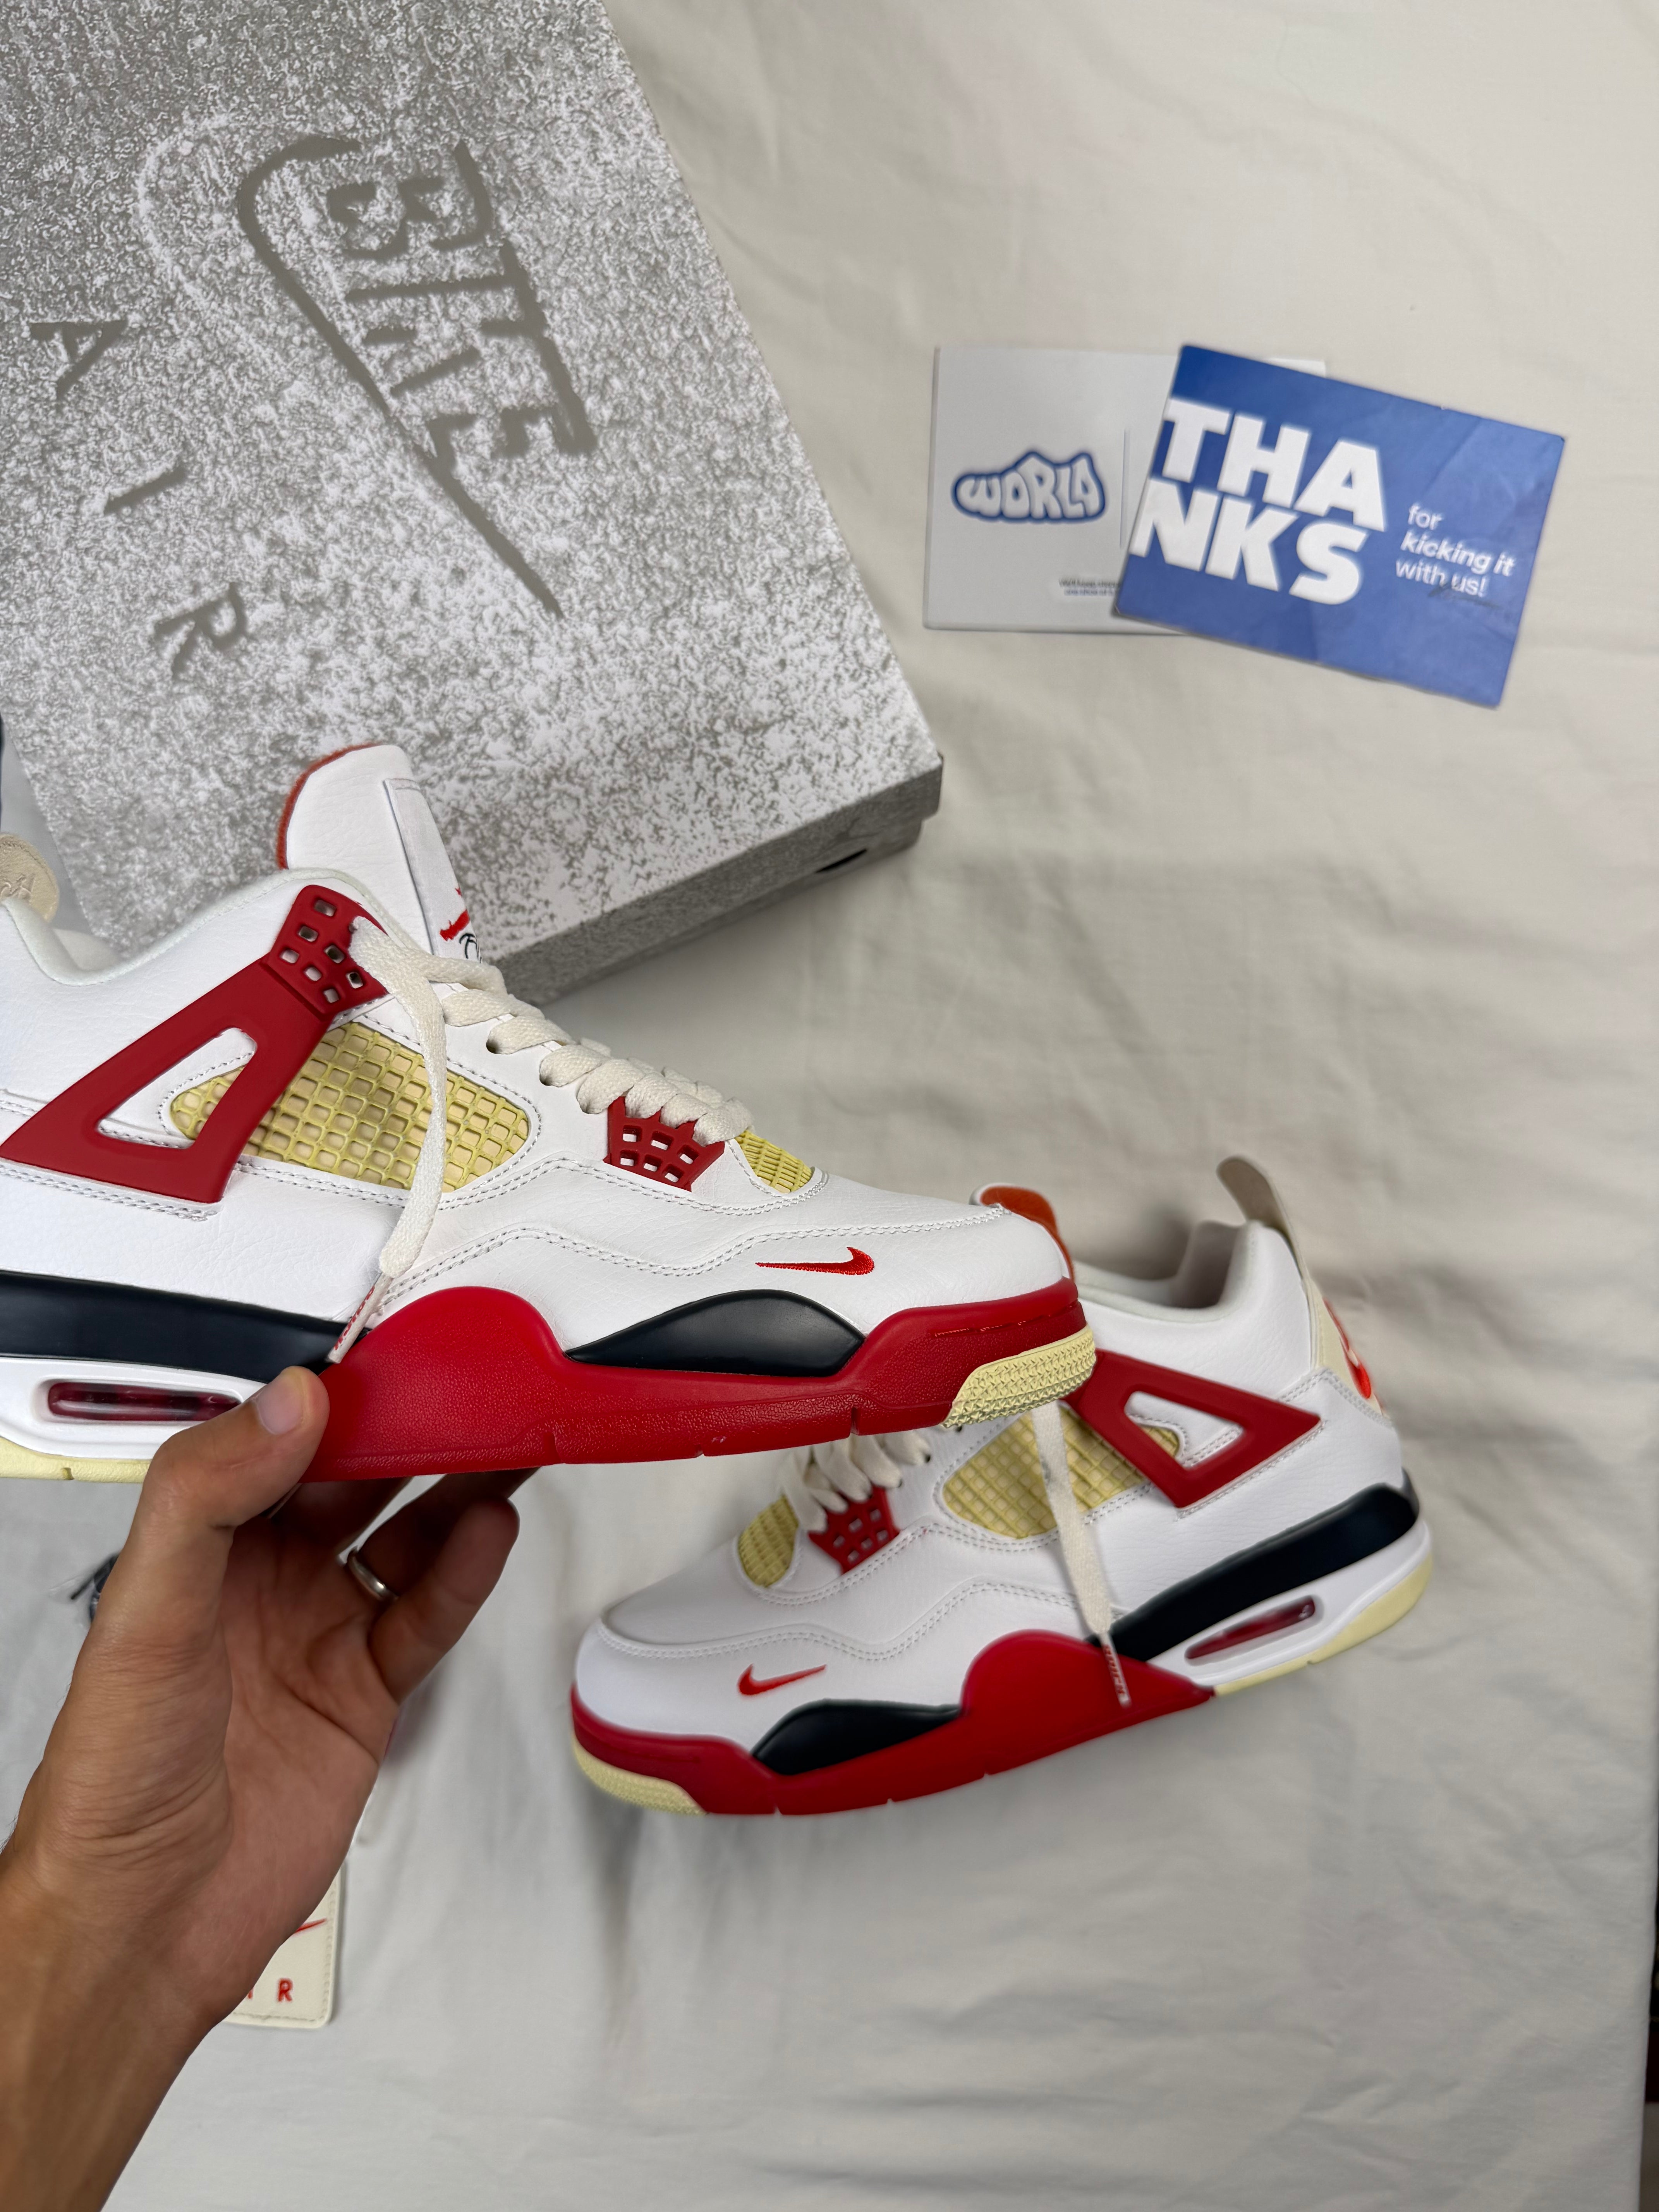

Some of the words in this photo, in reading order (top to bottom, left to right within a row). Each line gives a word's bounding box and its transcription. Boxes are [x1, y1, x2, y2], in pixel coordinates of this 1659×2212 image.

[29, 318, 252, 678] AIR
[1163, 398, 1385, 532] THA
[1128, 478, 1369, 605] NKS
[1400, 530, 1492, 575] kicking
[1493, 552, 1515, 577] it
[1408, 503, 1443, 530] for
[1396, 560, 1446, 586] with
[1451, 574, 1488, 598] us!
